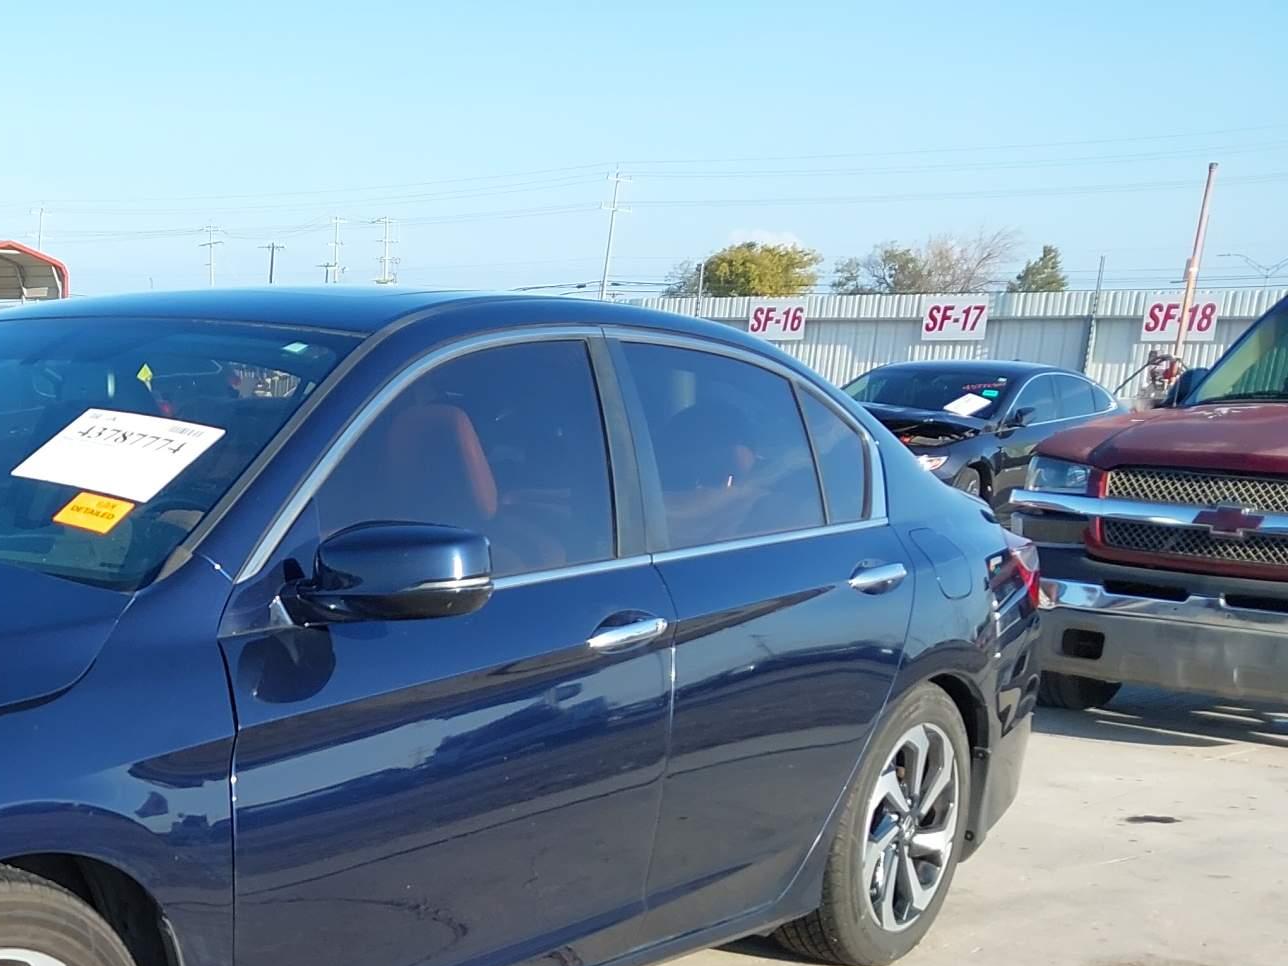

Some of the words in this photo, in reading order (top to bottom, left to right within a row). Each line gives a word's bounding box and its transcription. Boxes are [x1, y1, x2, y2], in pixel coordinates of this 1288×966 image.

[750, 305, 804, 332] SF-16
[924, 304, 986, 332] SF-17
[77, 425, 187, 454] 43787774
